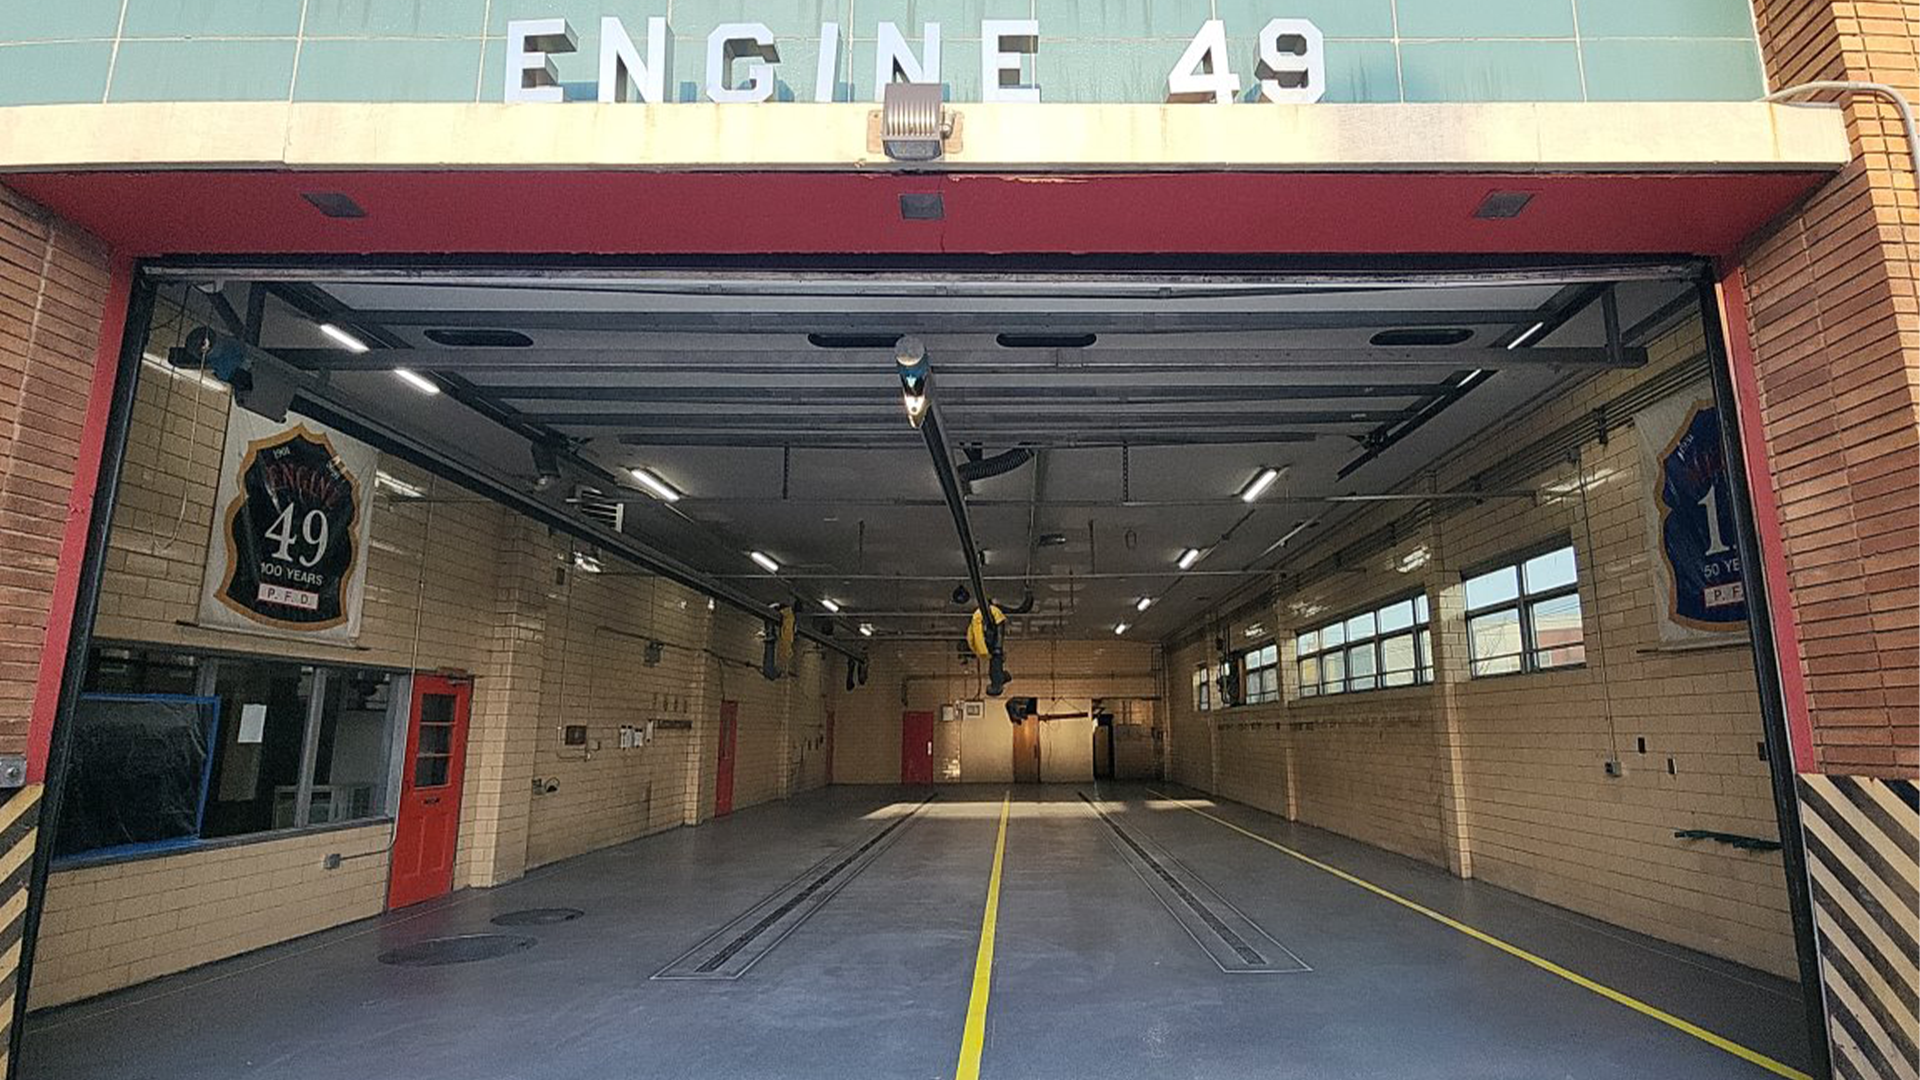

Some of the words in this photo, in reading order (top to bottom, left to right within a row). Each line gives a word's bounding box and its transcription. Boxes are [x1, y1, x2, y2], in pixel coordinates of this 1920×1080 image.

[504, 17, 1041, 103] ENGINE
[1167, 18, 1325, 103] 49
[265, 503, 330, 567] 49
[261, 562, 282, 577] 100
[287, 569, 325, 585] YEARS
[1704, 563, 1719, 577] 50
